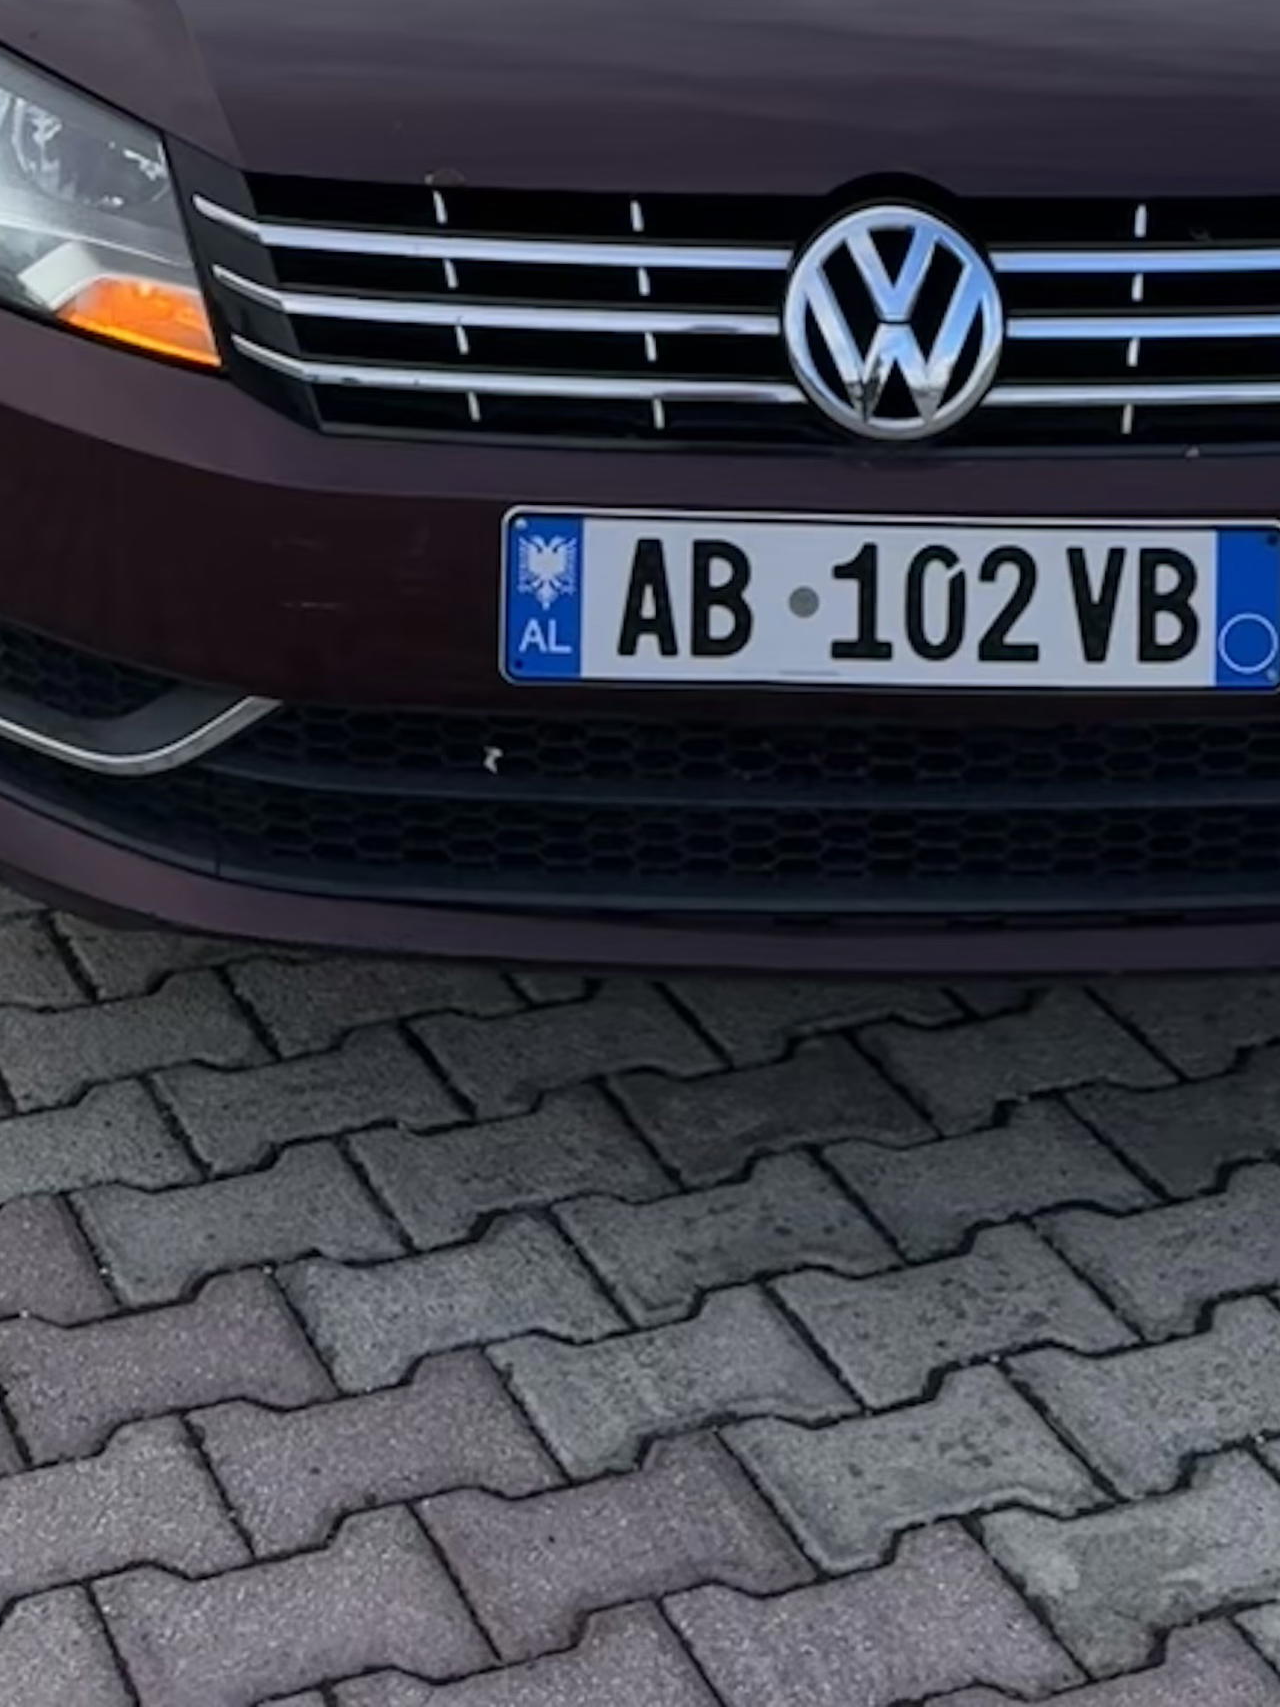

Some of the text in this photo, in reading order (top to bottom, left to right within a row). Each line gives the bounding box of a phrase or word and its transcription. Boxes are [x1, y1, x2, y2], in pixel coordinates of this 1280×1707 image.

[792, 213, 995, 432] VW
[519, 619, 572, 654] AL
[616, 538, 1200, 665] AB 102 VB
